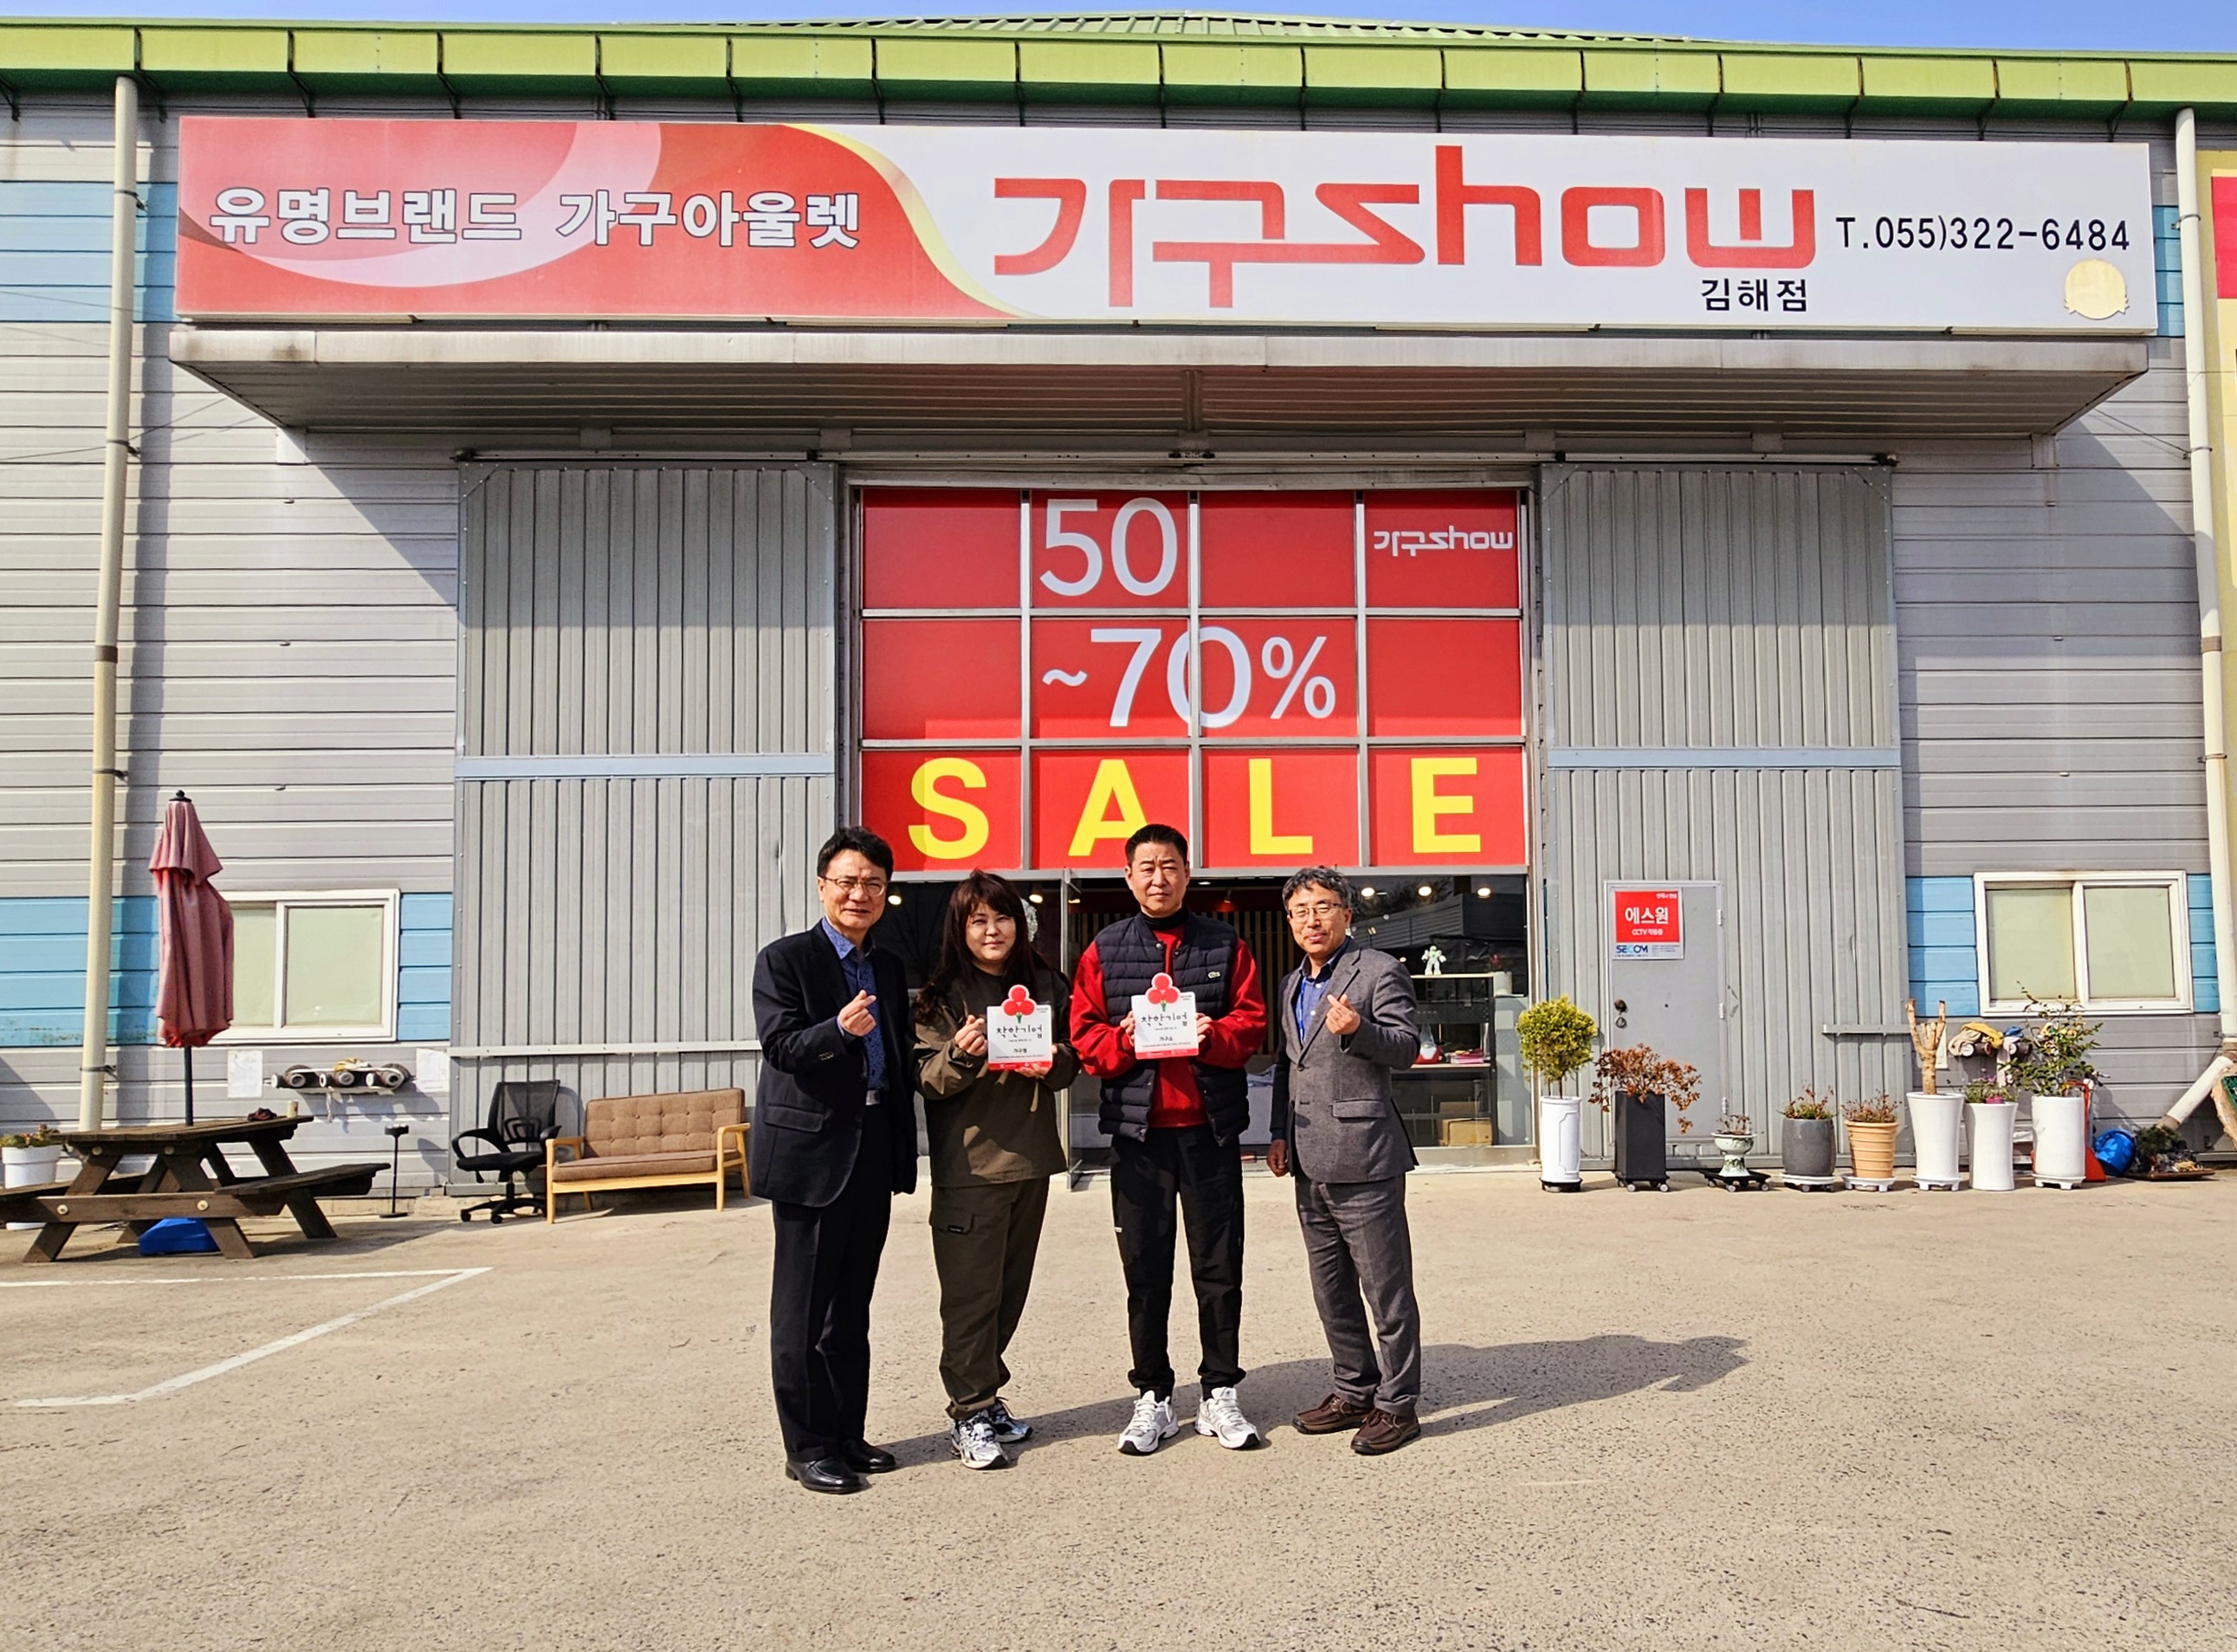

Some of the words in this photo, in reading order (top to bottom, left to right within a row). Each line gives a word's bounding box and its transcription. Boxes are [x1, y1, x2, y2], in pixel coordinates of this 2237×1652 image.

[210, 188, 521, 244] 유명브랜드
[556, 189, 859, 248] 가구아울렛
[1836, 215, 2130, 251] T.055)322-6484
[1702, 278, 1807, 312] 김해점
[1040, 498, 1178, 596] 50
[1625, 907, 1669, 925] 에스원
[1616, 945, 1648, 953] SECOM
[996, 1024, 1043, 1039] 착한기업
[1141, 1012, 1187, 1027] 착한기업
